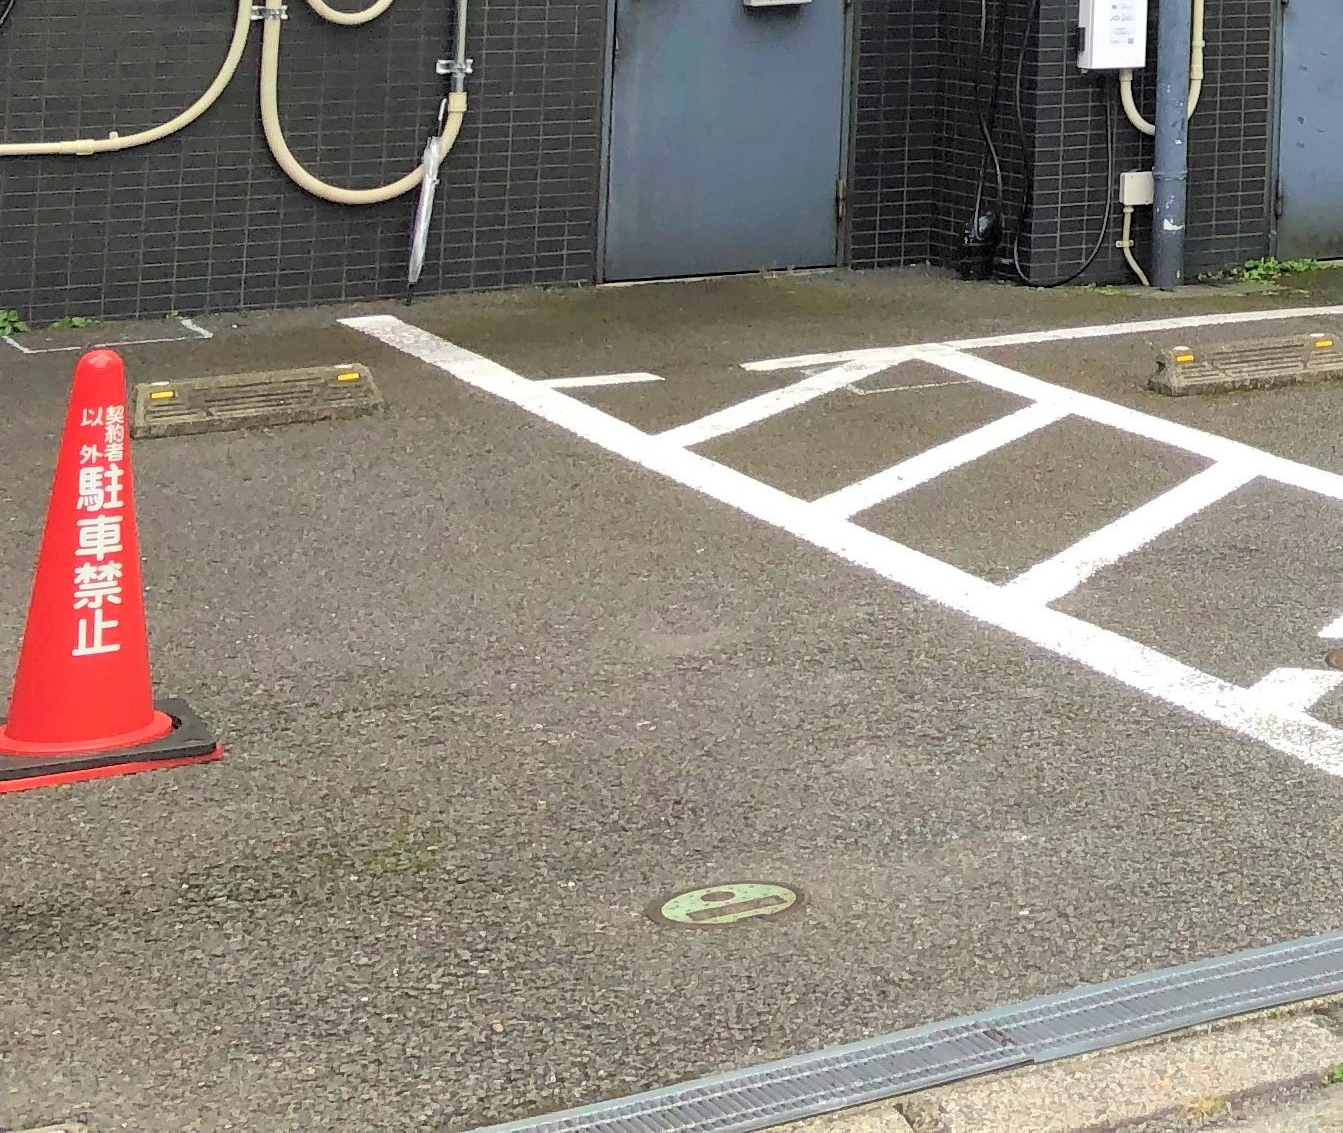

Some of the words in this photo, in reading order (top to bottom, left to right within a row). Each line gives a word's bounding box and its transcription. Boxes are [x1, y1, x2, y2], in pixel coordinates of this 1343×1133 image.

[79, 406, 104, 465] 以外
[104, 405, 126, 462] 契約者
[71, 463, 124, 656] 駐車禁止
